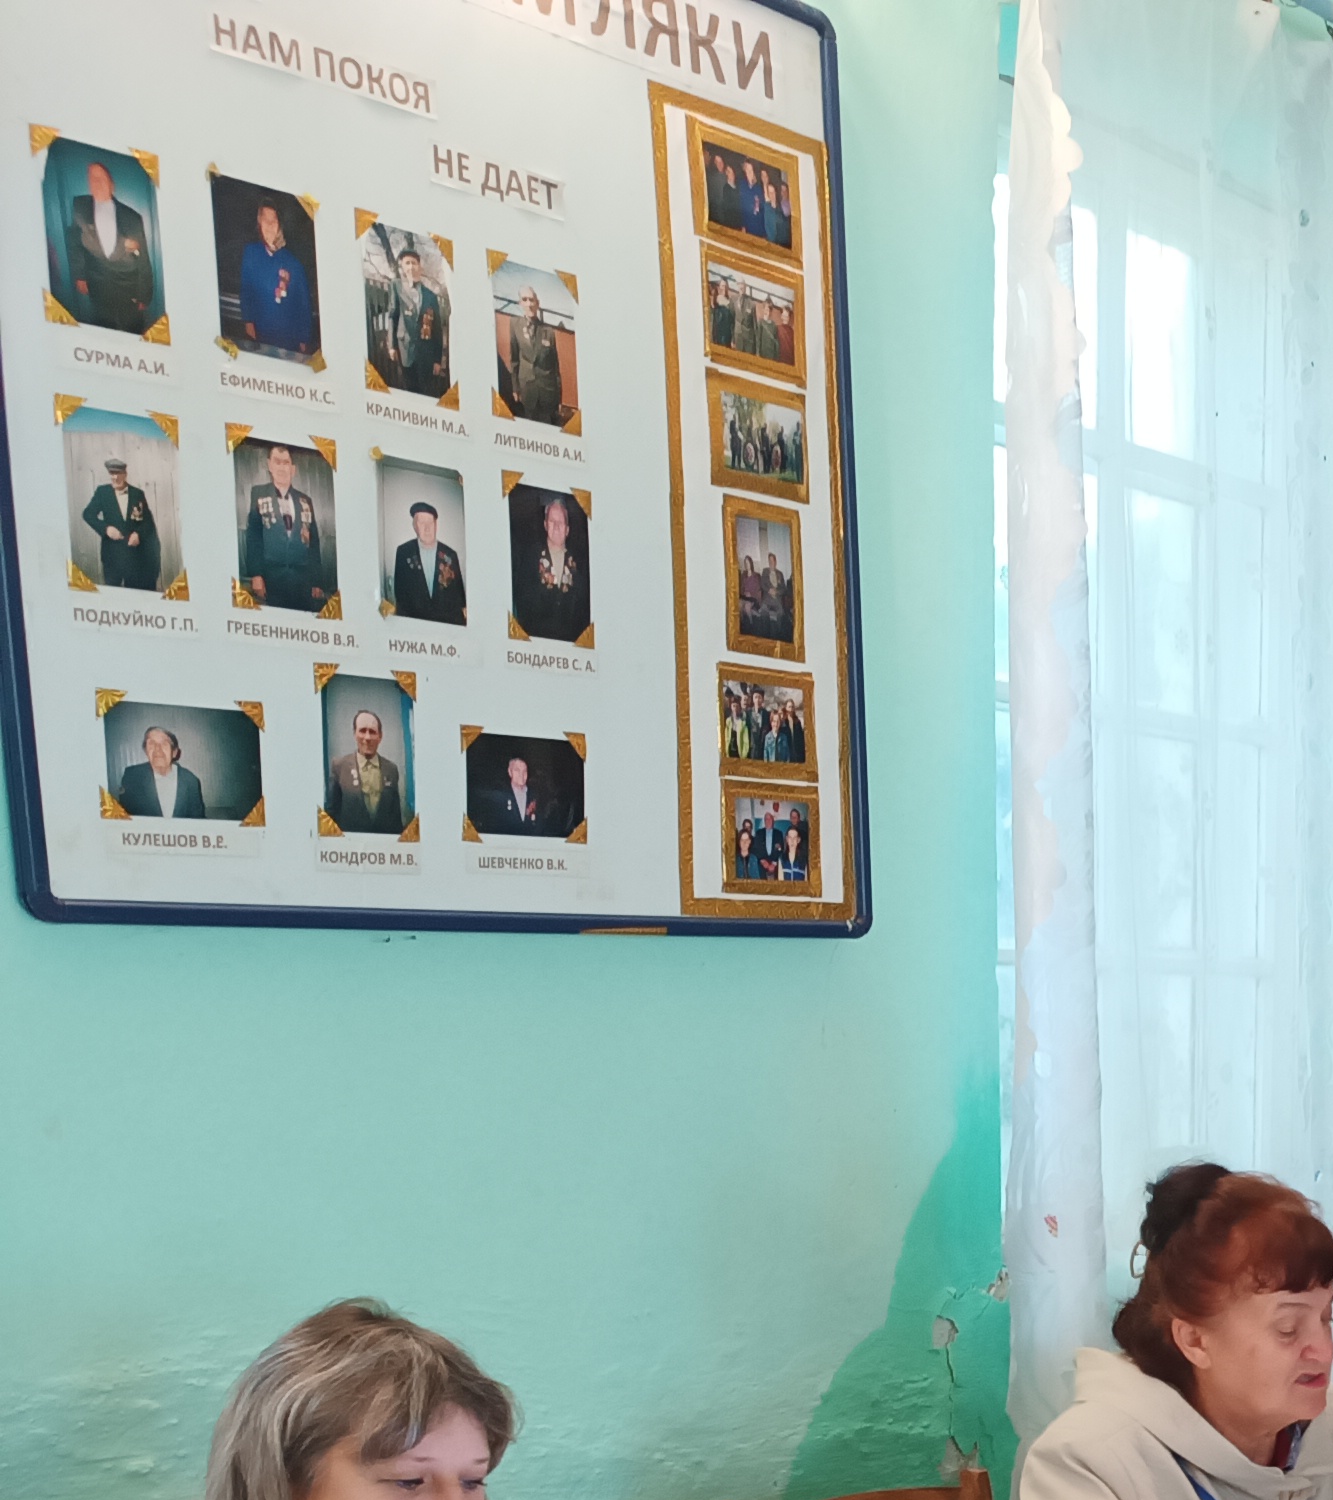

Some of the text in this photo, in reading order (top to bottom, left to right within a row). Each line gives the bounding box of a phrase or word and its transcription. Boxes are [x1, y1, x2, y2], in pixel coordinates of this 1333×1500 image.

[212, 13, 431, 113] НАМ ПОКОЯ
[512, 0, 774, 100] ЛЯКИ
[433, 144, 558, 210] НЕ ДАЕТ
[73, 347, 170, 377] СУРМА А.И.
[220, 371, 336, 406] ЕФИМЕНКО К.С.
[366, 402, 470, 437] КРАПИВИН М.А.
[494, 432, 586, 463] ЛИТВИНОВ А.И.
[73, 606, 199, 633] ПОДКУЙКО Г.П.
[226, 619, 360, 649] ГРЕБЕННИКОВ В.Я.
[388, 638, 461, 659] НУЖА М.Ф.
[507, 650, 597, 674] БОНДАРЕВ С. А.
[122, 832, 199, 848] КУЛЕШОВ
[319, 850, 418, 867] КОНДРОВ М.В.
[478, 856, 568, 871] ШЕВЧЕНКО В.К.
